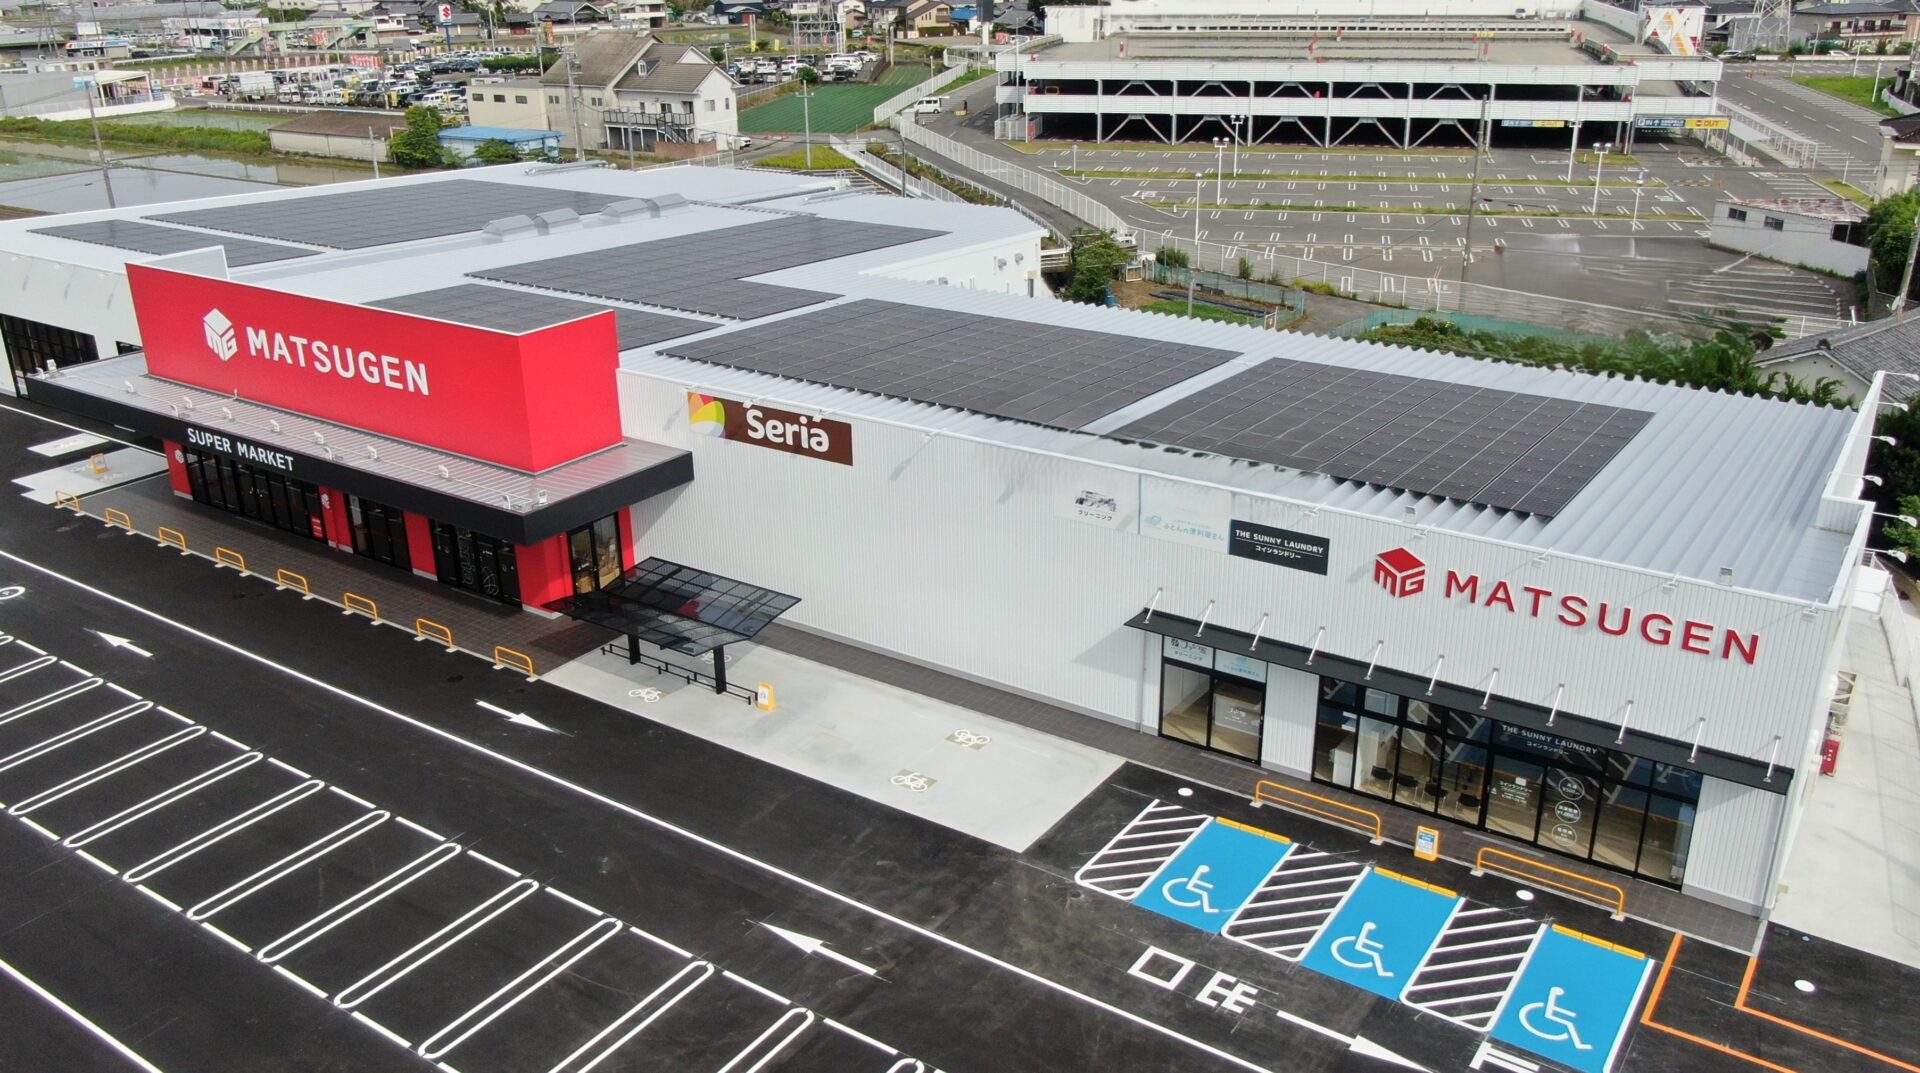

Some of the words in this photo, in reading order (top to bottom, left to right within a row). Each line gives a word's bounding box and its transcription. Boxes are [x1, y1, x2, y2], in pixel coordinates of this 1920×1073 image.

[246, 326, 429, 396] MATSUGEN
[187, 427, 232, 454] SUPER
[236, 441, 294, 472] MARKET
[746, 408, 830, 453] Seria
[1235, 529, 1251, 539] THE
[1253, 533, 1282, 545] SUNNY
[1284, 540, 1324, 554] LAUNDRY
[1255, 545, 1302, 559] コインランドリー
[1444, 568, 1760, 665] MATSUGEN
[1502, 724, 1519, 734] THE
[1521, 730, 1552, 742] SUNNY
[1555, 738, 1598, 755] LAUNDRY
